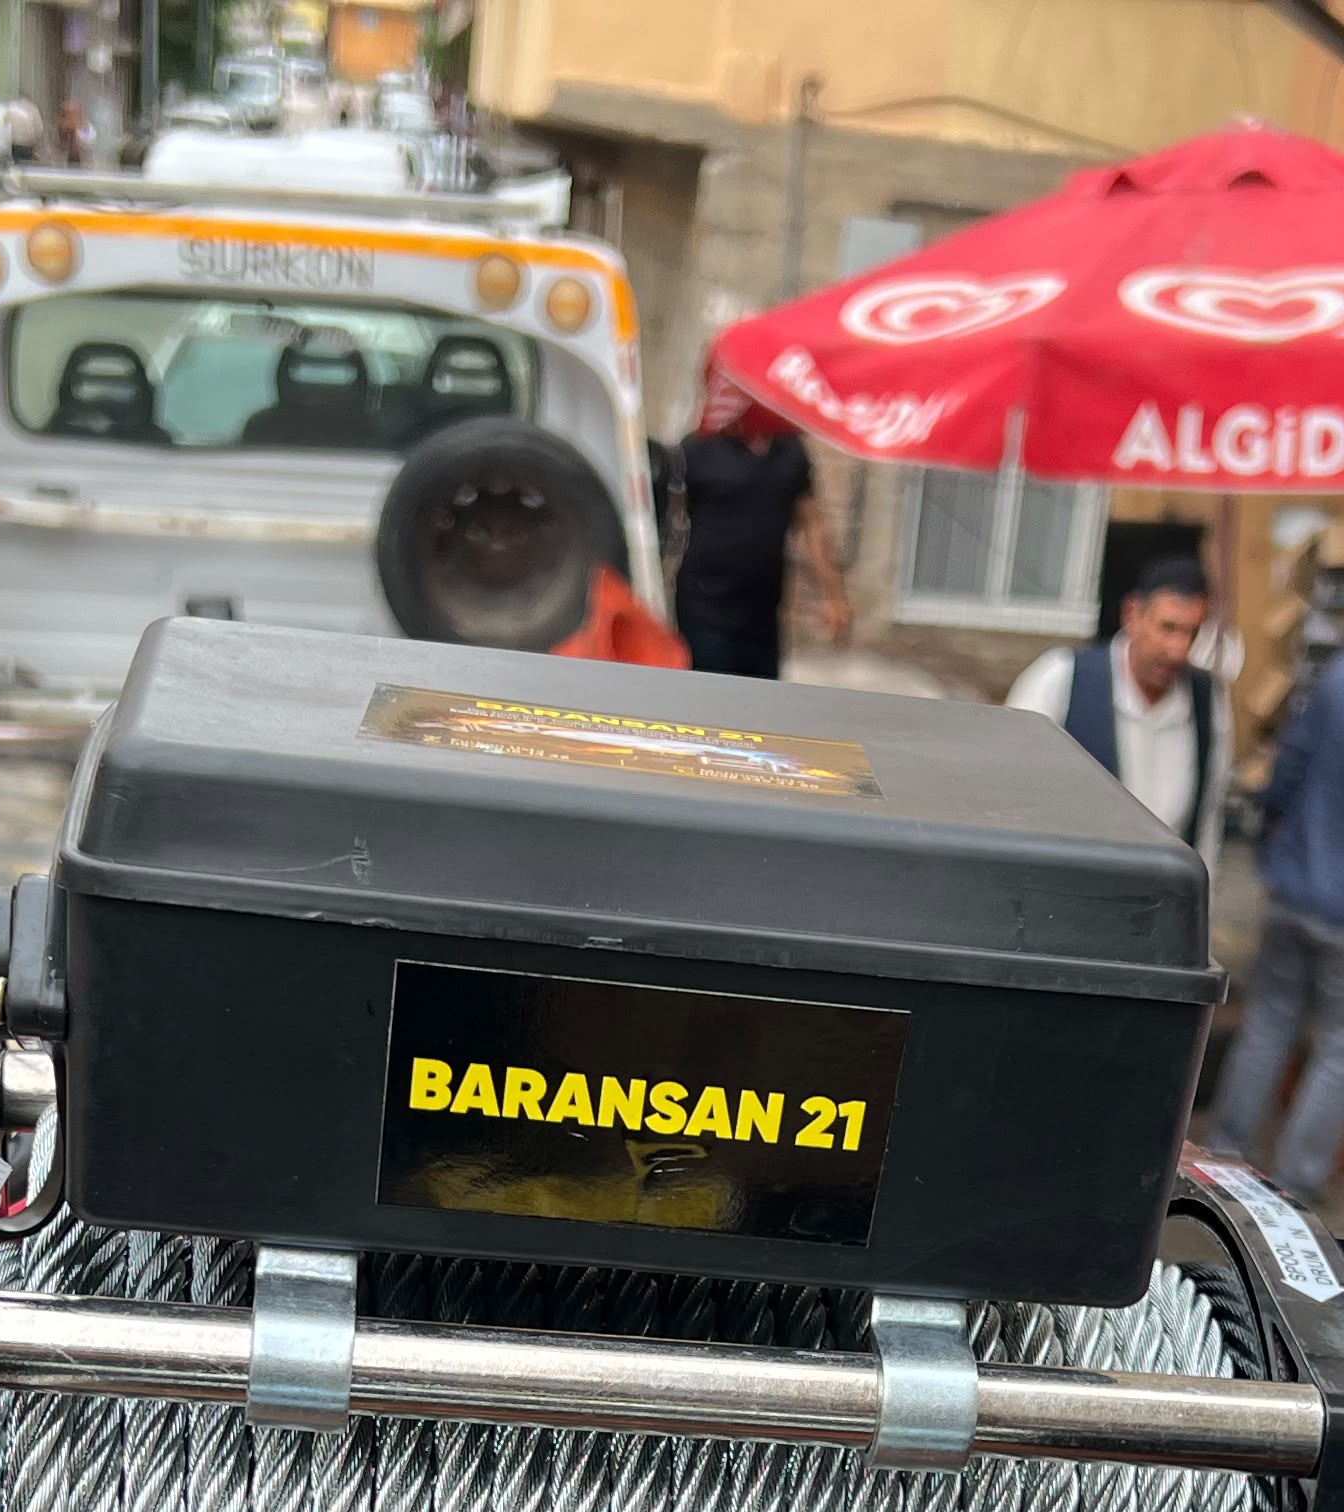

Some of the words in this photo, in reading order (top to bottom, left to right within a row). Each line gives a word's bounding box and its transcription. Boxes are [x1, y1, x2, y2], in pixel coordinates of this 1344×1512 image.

[476, 701, 705, 736] BARANSAN
[409, 1056, 785, 1144] BARANSAN
[794, 1097, 867, 1152] 21
[1274, 1242, 1307, 1283] SPOOL
[1301, 1249, 1334, 1287] DRUM
